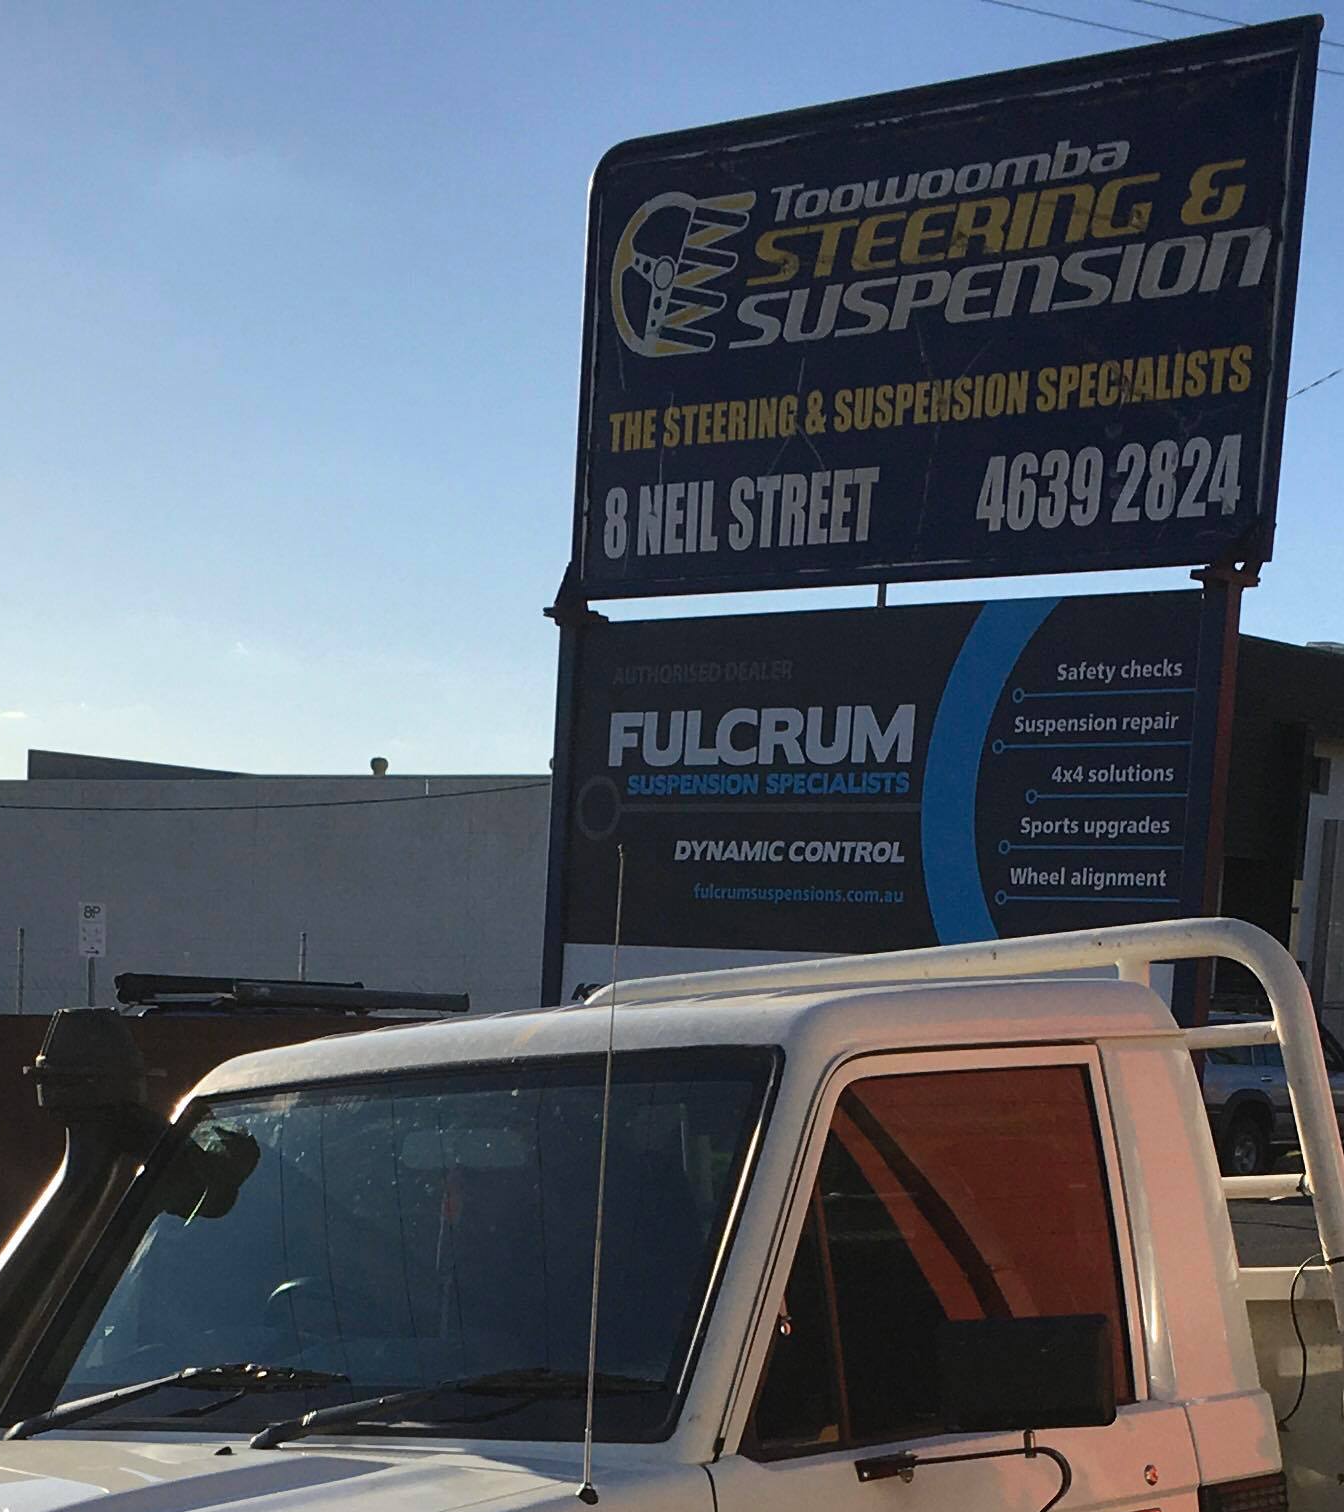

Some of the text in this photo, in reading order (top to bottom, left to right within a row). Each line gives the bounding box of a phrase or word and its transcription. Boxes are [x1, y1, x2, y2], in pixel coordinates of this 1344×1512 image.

[771, 139, 1131, 224] Toowoomba
[746, 158, 1247, 288] STEERING &
[728, 224, 1274, 351] SUSPENSION
[609, 344, 1255, 454] THE STEERING & SUSPENSION SPECIALISTS
[976, 434, 1244, 533] 4639 2824
[602, 466, 881, 560] 8 NEIL STREET
[613, 659, 793, 685] AUTHORISED DEALER
[1057, 658, 1183, 684] Safety checks
[607, 703, 916, 767] FULCRUM
[1013, 711, 1180, 738] Suspension repair
[627, 771, 910, 796] SUSPENSION SPECIALISTS
[1051, 763, 1174, 784] 4x4 solutions
[1020, 815, 1171, 840] Sports upgrades
[673, 840, 905, 864] DYNAMIC CONTROL
[1009, 866, 1167, 892] Wheel alignment
[693, 882, 905, 904] fulcrumsuspensions.com.au
